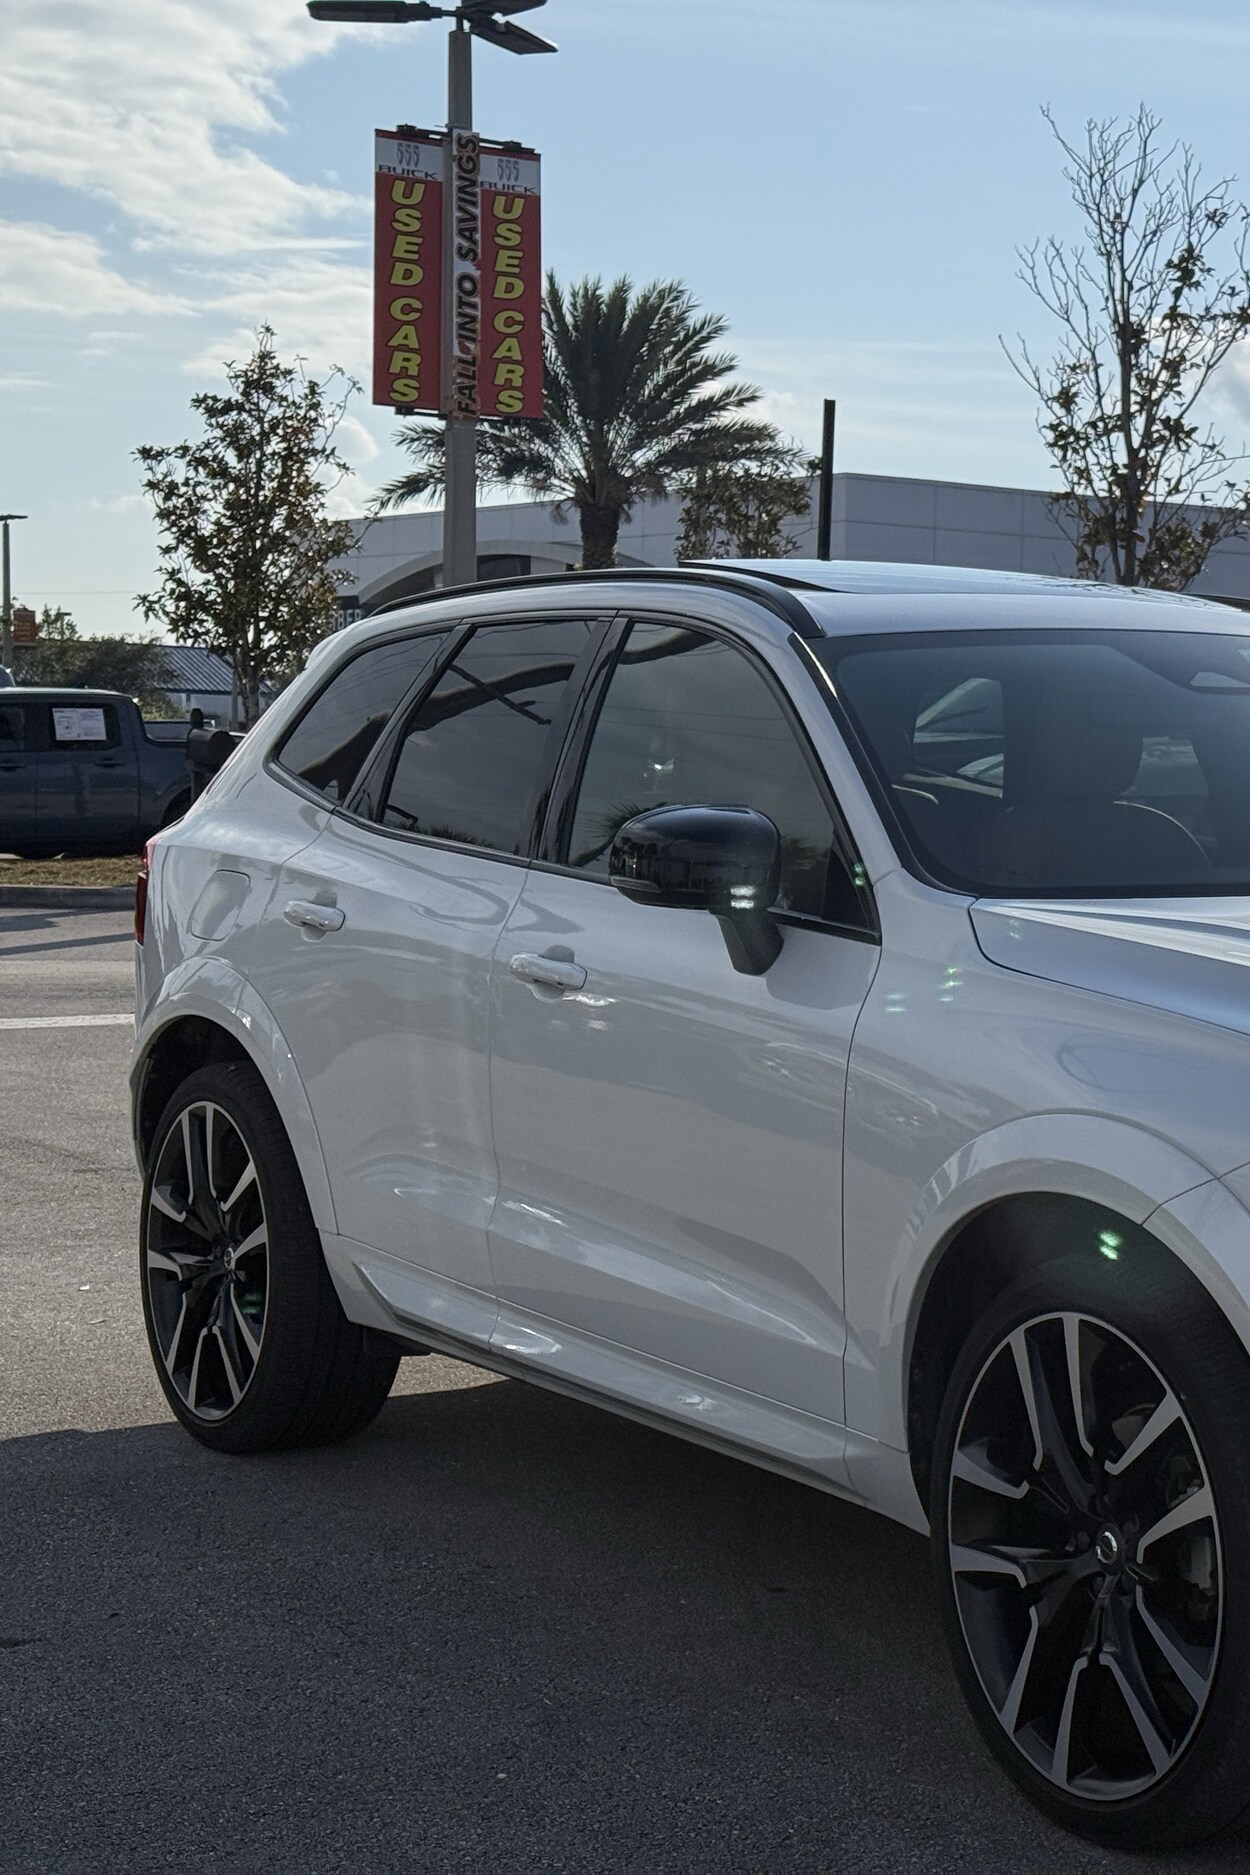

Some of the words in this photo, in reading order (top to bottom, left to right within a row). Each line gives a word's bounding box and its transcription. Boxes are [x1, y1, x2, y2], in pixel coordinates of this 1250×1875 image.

[378, 164, 438, 180] BUICK
[456, 133, 479, 263] SAVINGS
[480, 180, 538, 195] BUICK
[390, 179, 426, 286] USED
[491, 195, 526, 300] USED
[386, 296, 424, 402] CARS
[456, 272, 479, 344] INTO
[456, 356, 478, 415] FALL
[491, 310, 526, 413] CARS
